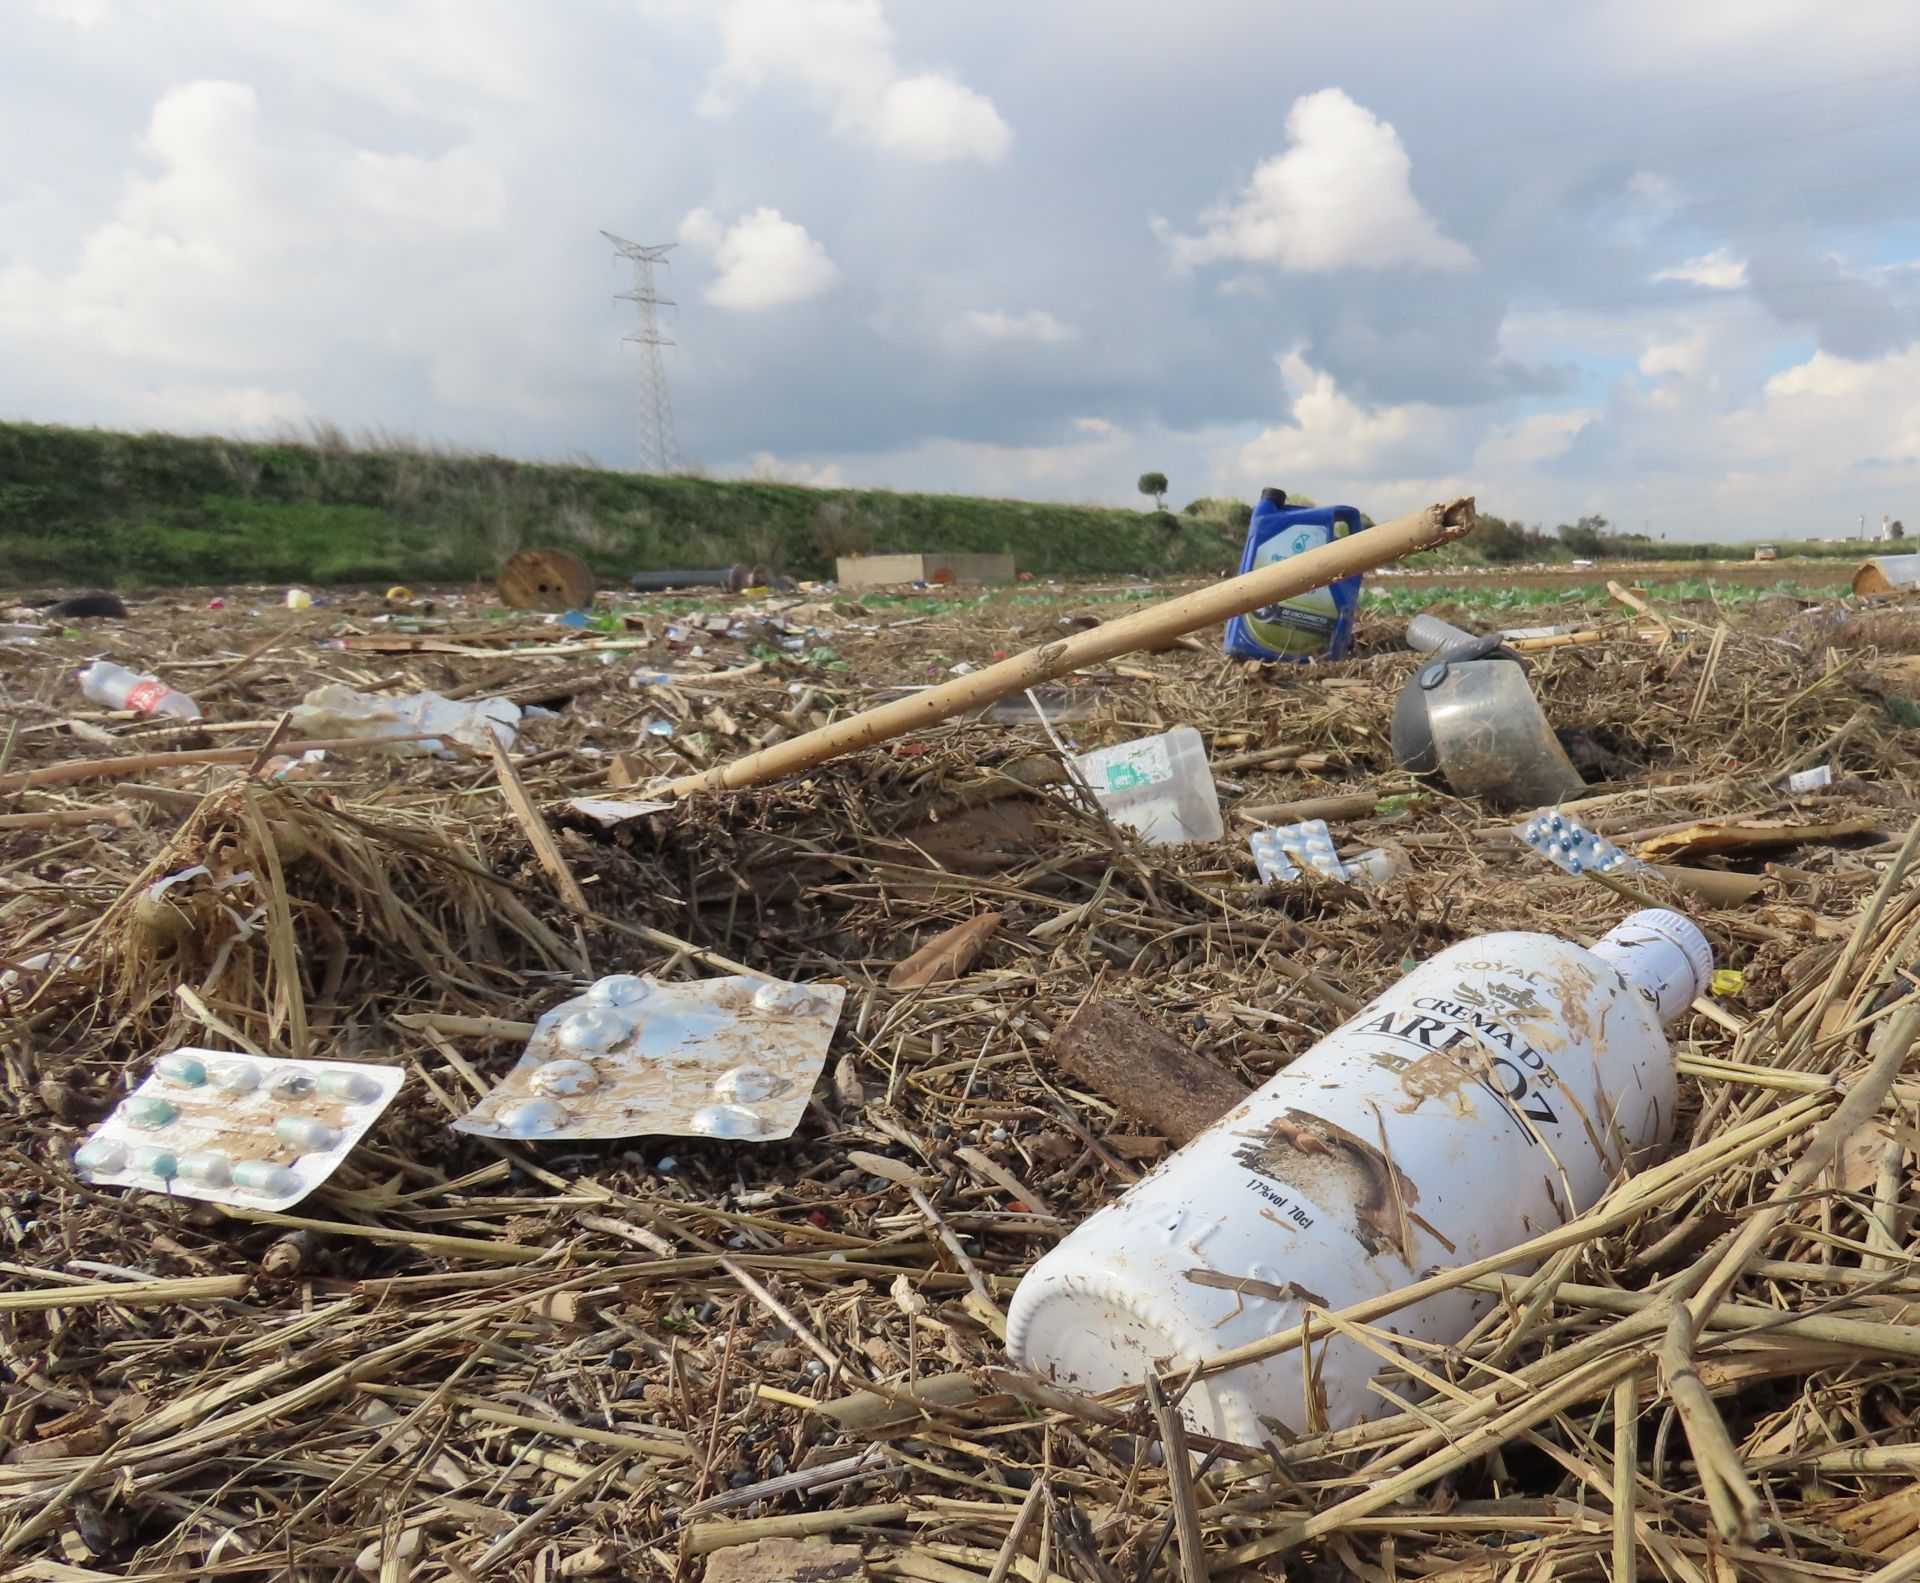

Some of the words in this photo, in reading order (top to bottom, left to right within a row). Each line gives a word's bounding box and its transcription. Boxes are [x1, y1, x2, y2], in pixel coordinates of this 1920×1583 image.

[1454, 960, 1539, 987] ROYAL
[1412, 997, 1513, 1051] CREMA
[1518, 1041, 1559, 1089] DE
[1246, 1179, 1289, 1208] 17%vol
[1287, 1205, 1314, 1230] 70cl
